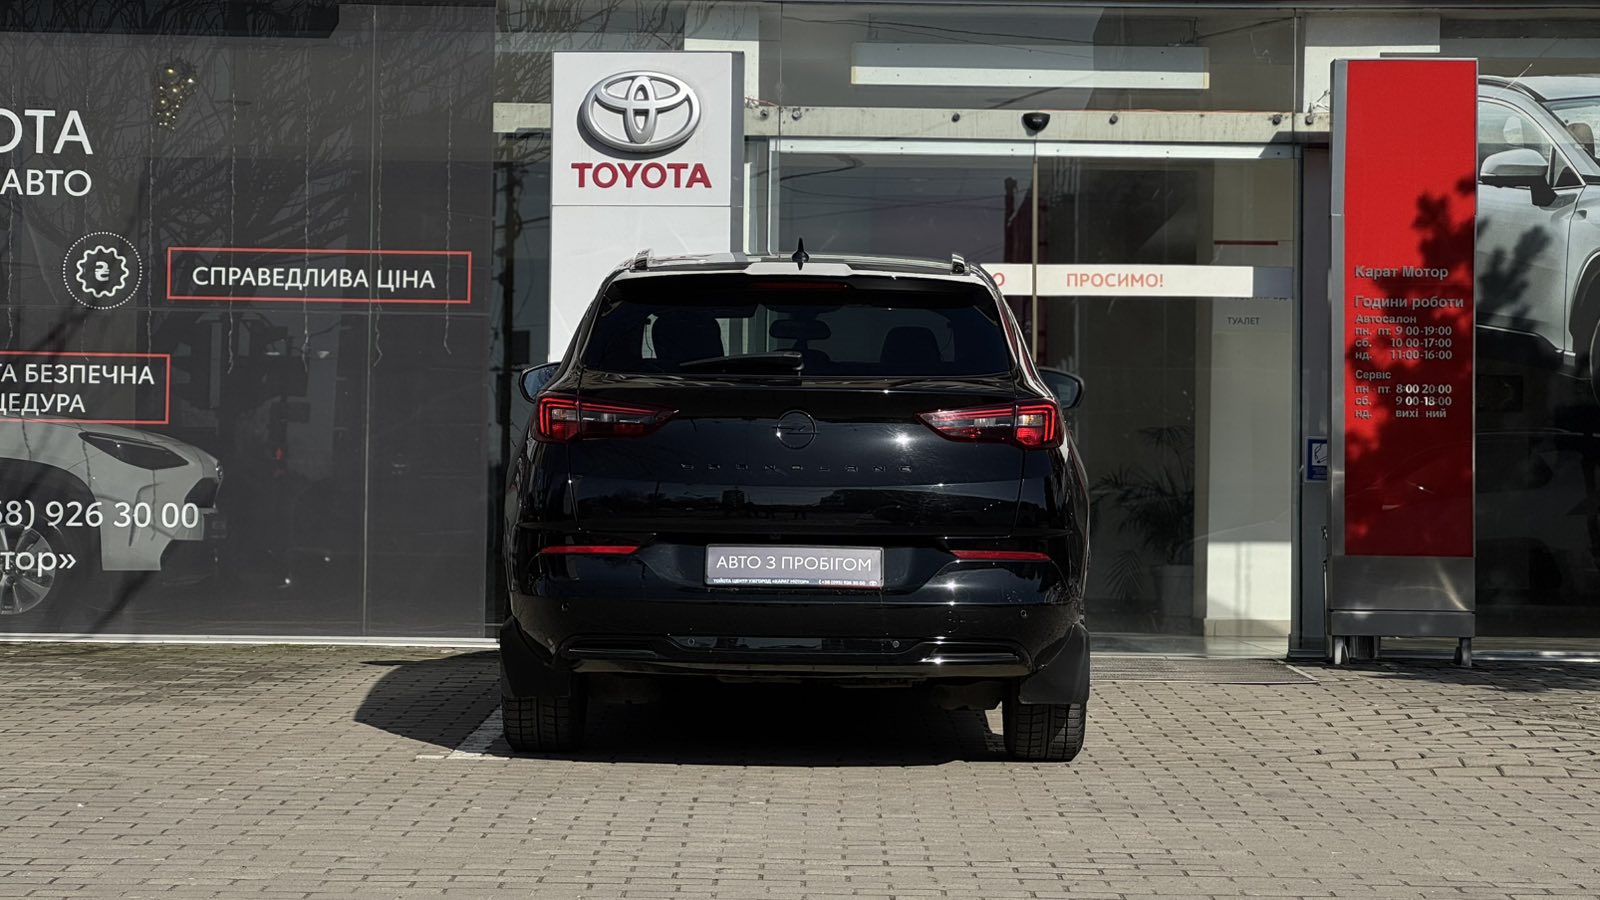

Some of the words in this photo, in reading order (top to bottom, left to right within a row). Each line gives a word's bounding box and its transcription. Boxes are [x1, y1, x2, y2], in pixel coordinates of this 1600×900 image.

[0, 168, 92, 197] АВТО
[571, 162, 712, 189] TOYOTA
[192, 266, 369, 290] СПРАВЕДЛИВА
[376, 269, 436, 292] ЦІНА
[1066, 272, 1164, 288] ПРОСИМО!
[1355, 266, 1398, 280] Карат
[1402, 266, 1449, 281] Мотор
[1355, 296, 1408, 309] Години
[1412, 296, 1464, 310] роботи
[1227, 316, 1260, 325] ТУАЛЕТ
[1355, 314, 1417, 324] Автосалон
[25, 363, 156, 385] БЕЗПЕЧНА
[1355, 369, 1392, 380] Сервіс
[0, 499, 35, 530] 8)
[45, 500, 104, 527] 926
[113, 501, 152, 528] 30
[161, 502, 199, 529] 00
[0, 551, 77, 577] тор»
[716, 555, 761, 569] АВТО
[781, 557, 872, 571] ПРОБІГОМ
